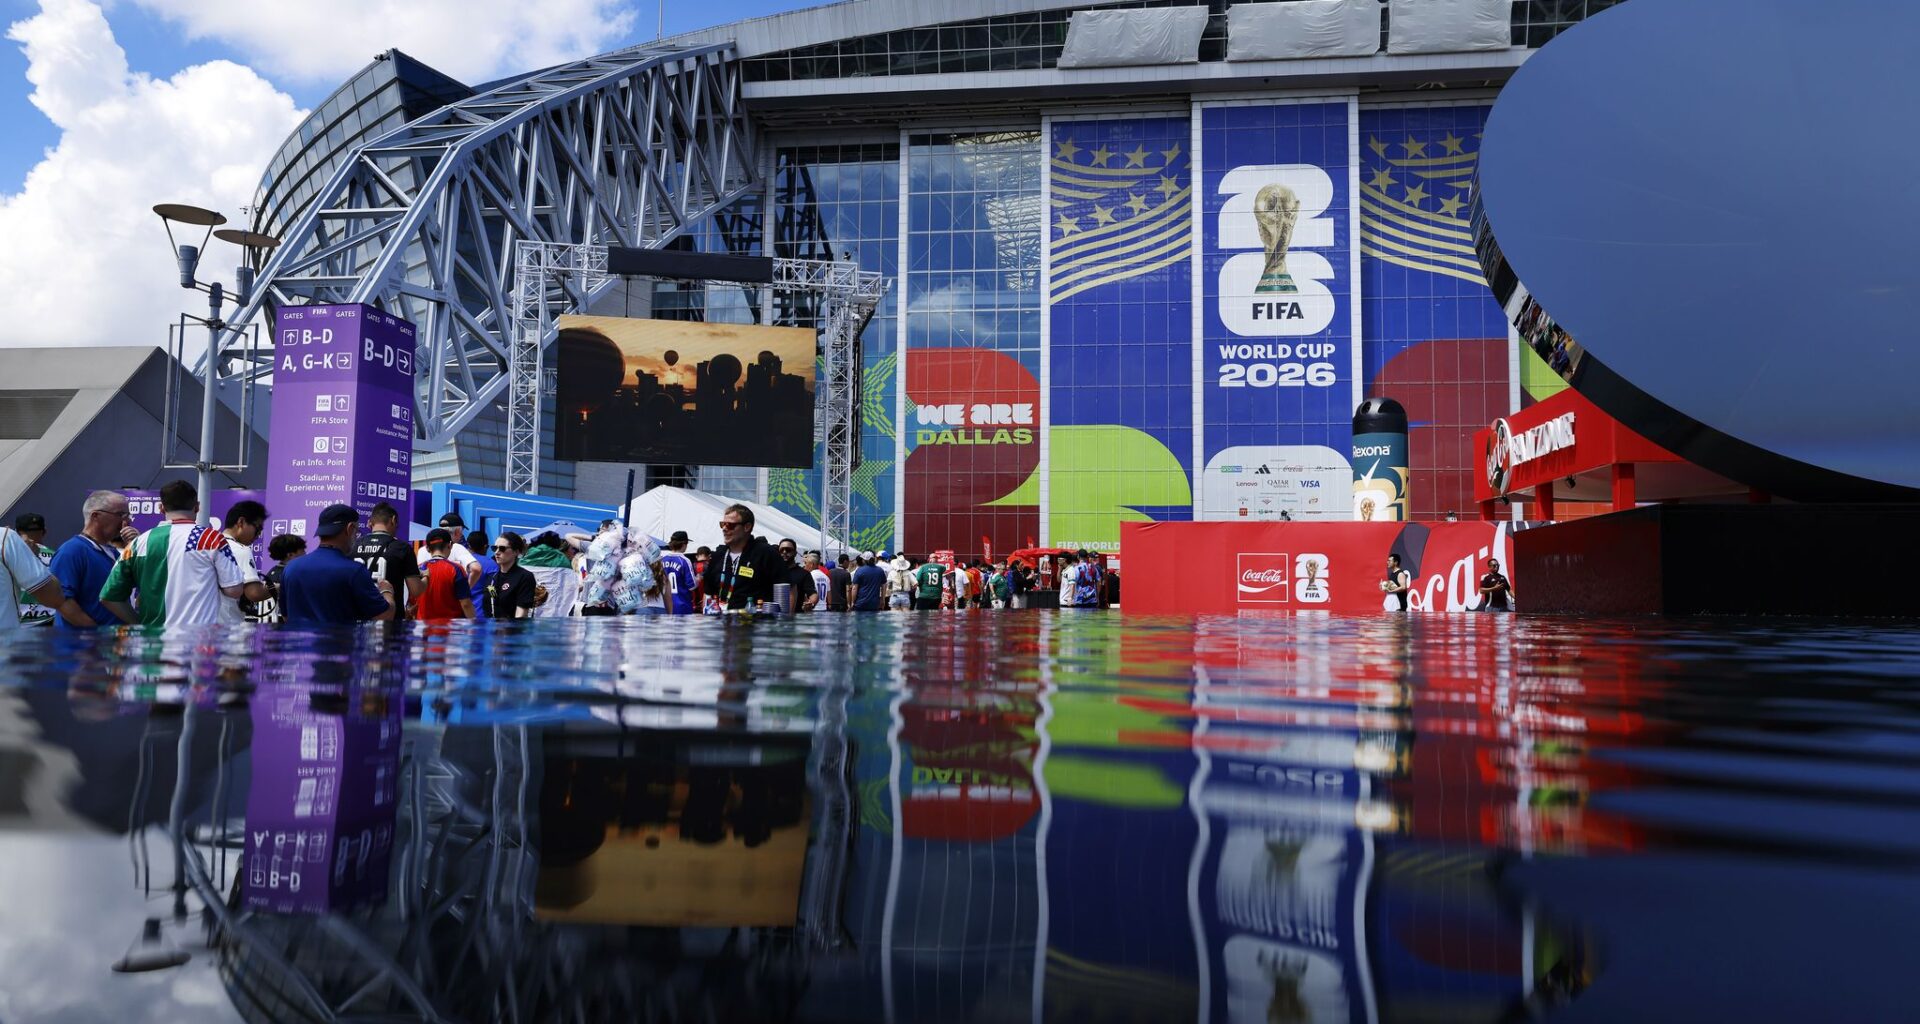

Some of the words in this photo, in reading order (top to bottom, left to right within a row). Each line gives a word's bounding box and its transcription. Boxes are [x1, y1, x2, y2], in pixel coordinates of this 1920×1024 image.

[283, 312, 304, 320] GATES
[335, 310, 356, 318] GATES
[1252, 302, 1304, 320] FIFA
[366, 313, 381, 324] GATES
[400, 326, 413, 337] GATES
[1219, 343, 1291, 359] WORLD
[1295, 343, 1336, 359] CUP
[281, 354, 297, 373] A,
[1218, 362, 1336, 388] 2026
[311, 416, 327, 424] FIFA
[329, 416, 349, 424] Store
[916, 404, 965, 426] WE
[970, 403, 1033, 425] ARE
[916, 428, 1033, 445] DALLAS
[285, 484, 325, 493] Experience
[1300, 480, 1320, 488] VISA
[305, 499, 333, 508] Lounge
[356, 500, 376, 508] Restricte
[1056, 541, 1079, 549] FIFA
[1080, 541, 1120, 549] WORLD
[927, 572, 939, 585] 19
[1242, 568, 1284, 582] Coca-Cola
